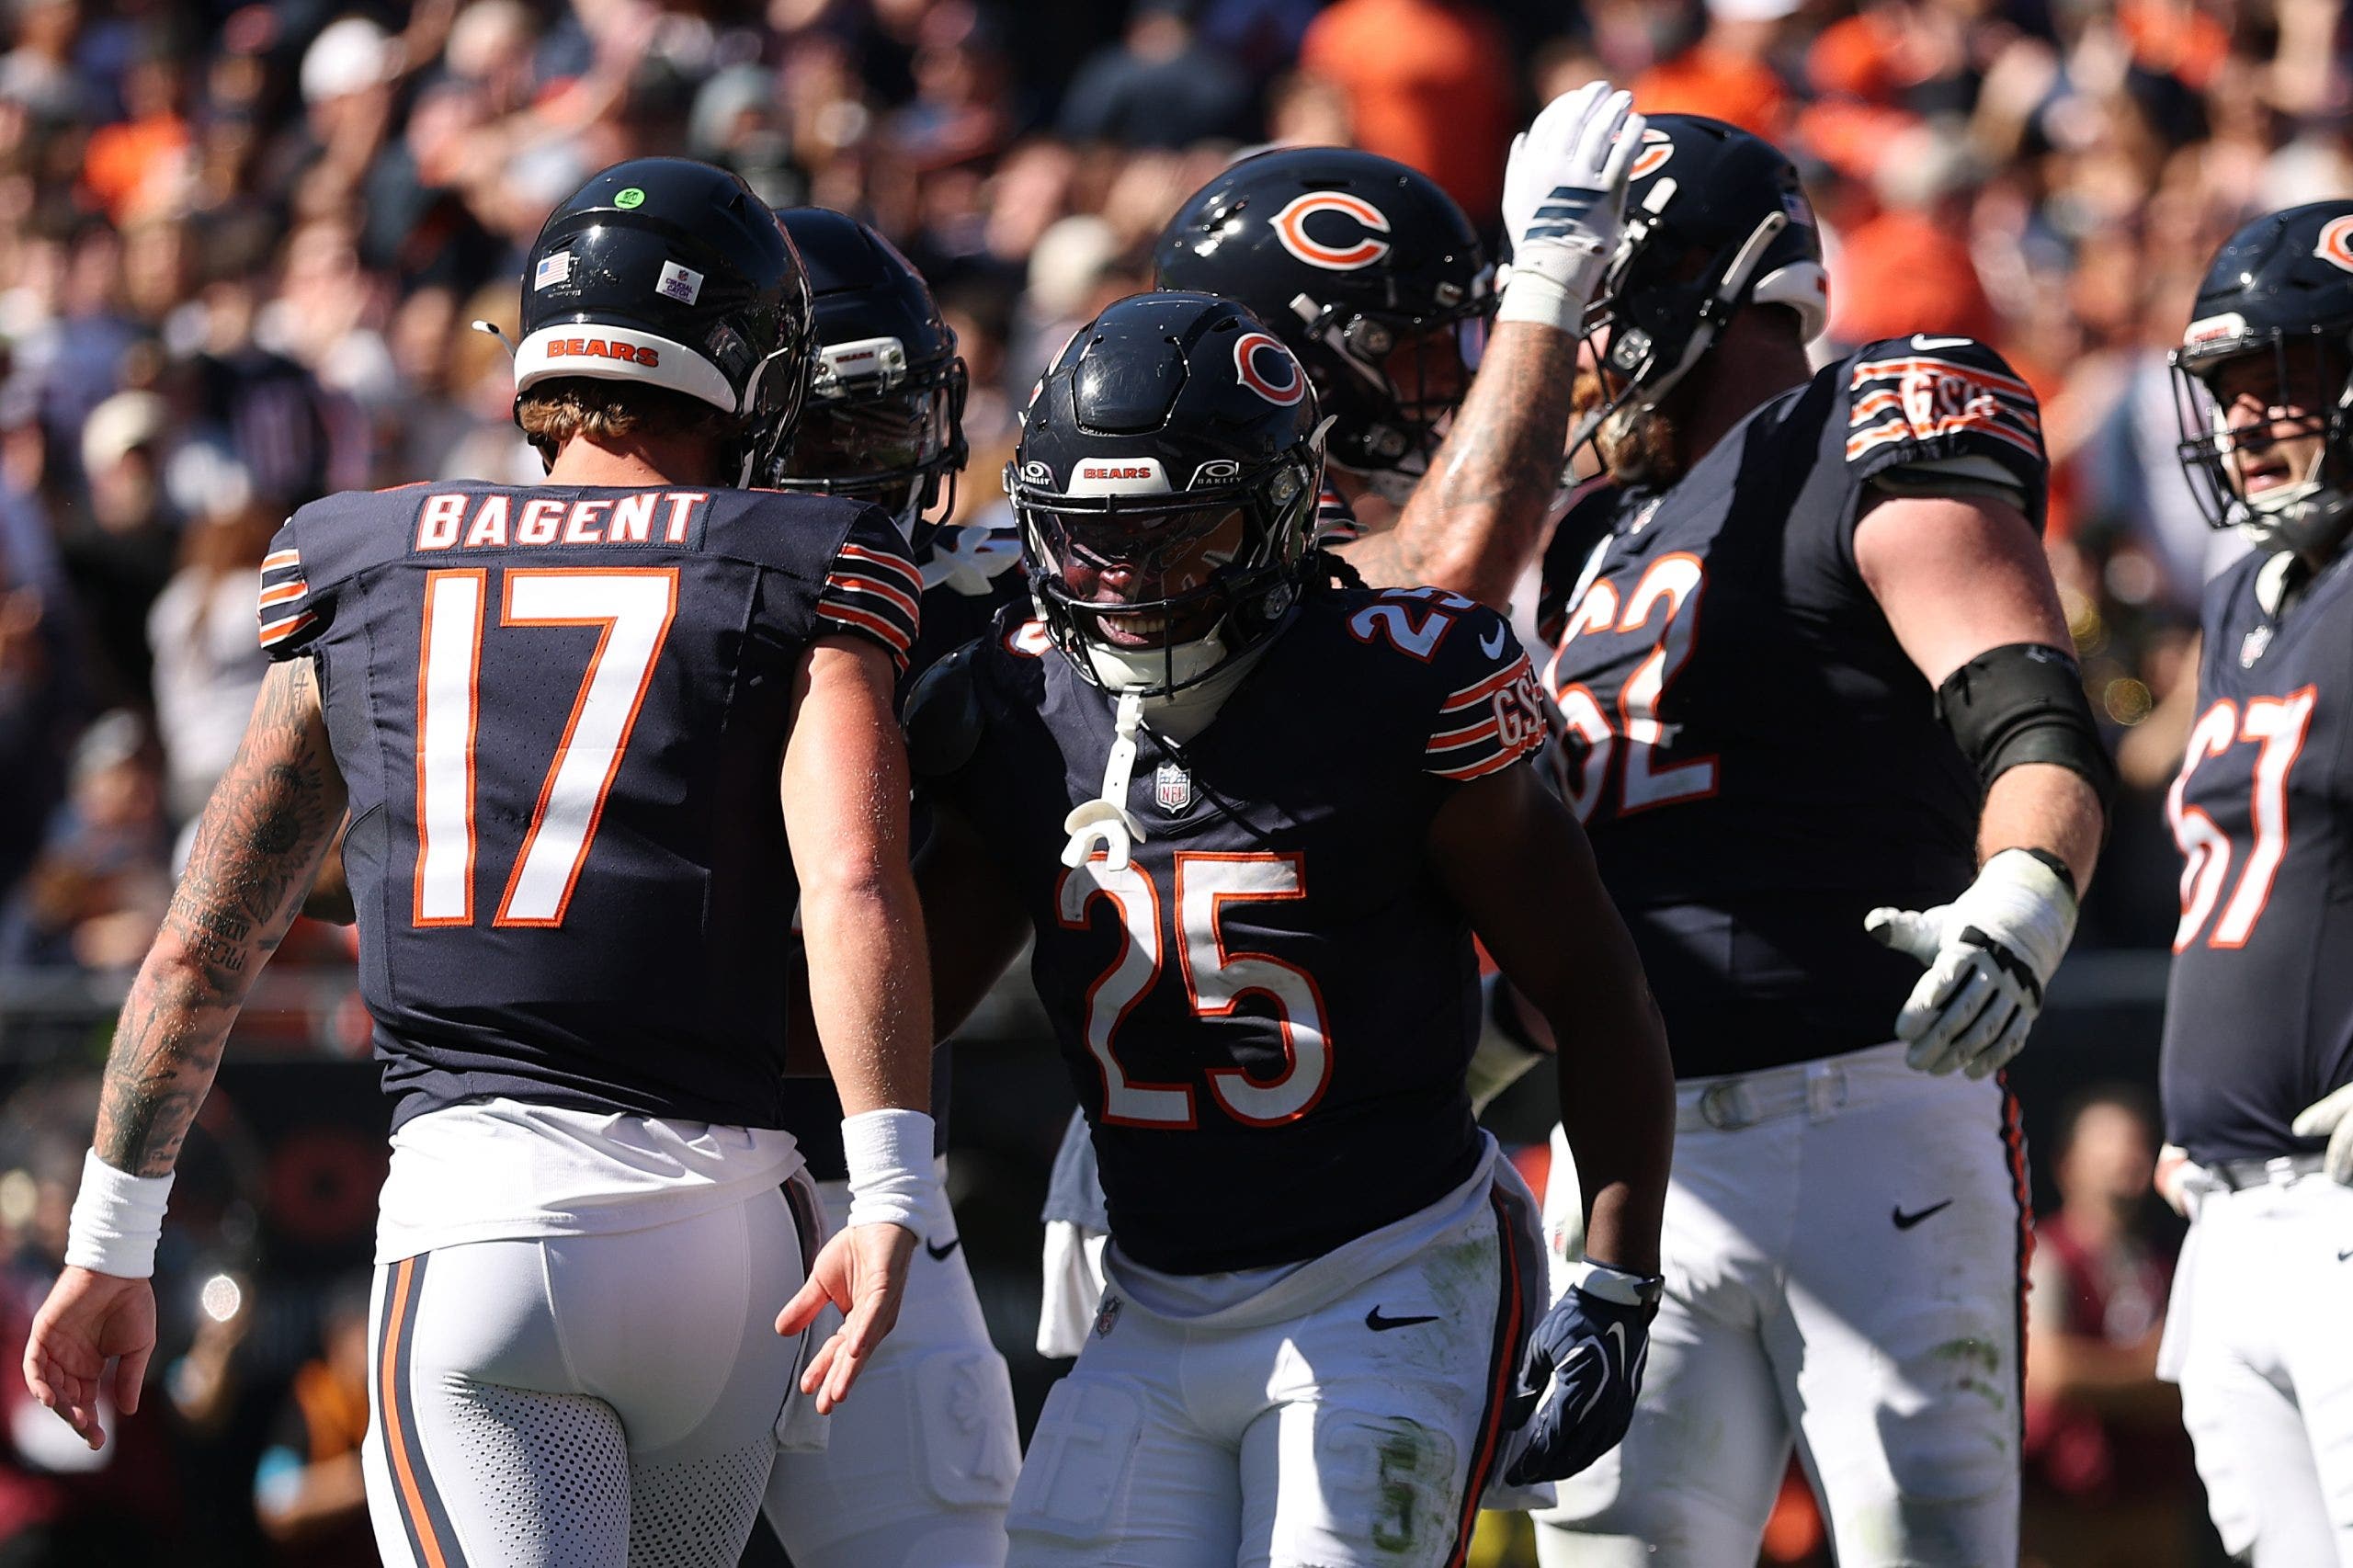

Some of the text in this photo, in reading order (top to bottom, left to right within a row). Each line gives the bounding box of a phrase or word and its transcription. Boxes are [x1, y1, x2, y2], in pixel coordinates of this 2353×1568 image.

[547, 338, 659, 368] BEARS
[416, 493, 709, 551] BAGENT
[1084, 467, 1152, 479] BEARS
[413, 566, 681, 929] 17
[1542, 551, 1720, 825] 62
[1162, 786, 1186, 804] NFL
[2165, 683, 2318, 956] 67
[1054, 850, 1334, 1131] 25
